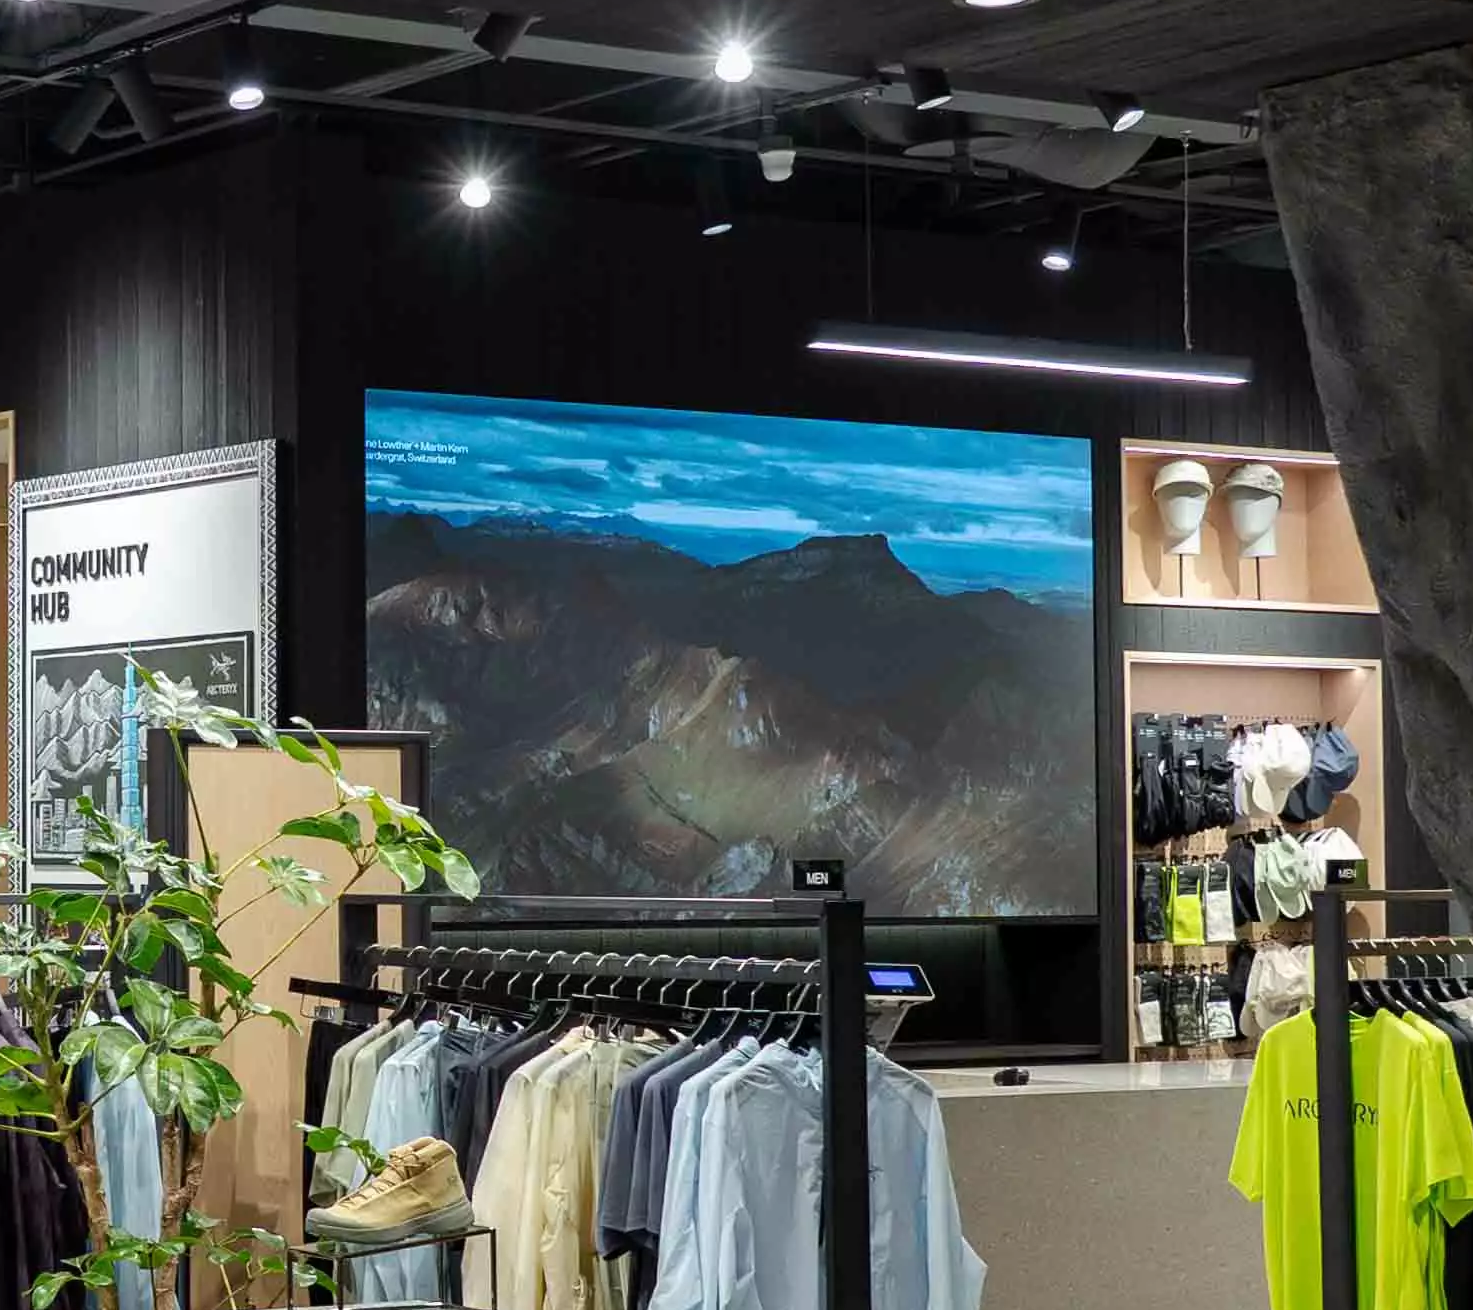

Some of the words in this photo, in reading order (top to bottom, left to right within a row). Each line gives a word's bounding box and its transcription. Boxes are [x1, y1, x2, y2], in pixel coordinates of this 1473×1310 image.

[31, 542, 149, 587] COMMUNITY
[31, 591, 70, 624] HUB
[806, 871, 829, 885] MEN
